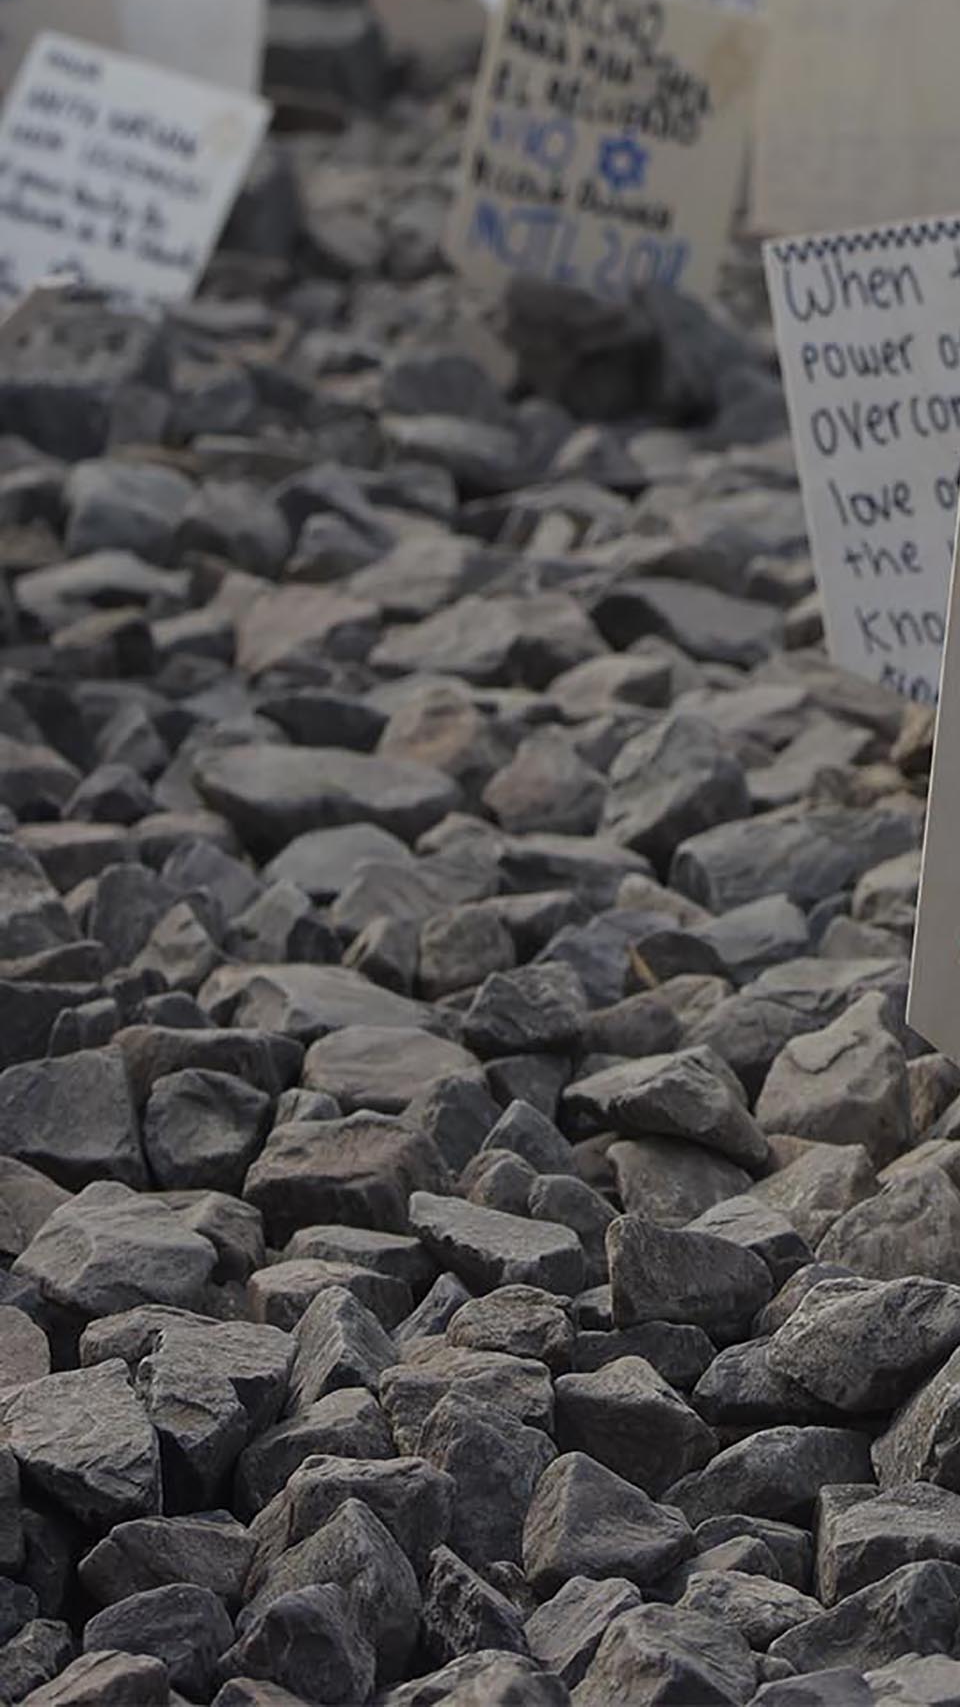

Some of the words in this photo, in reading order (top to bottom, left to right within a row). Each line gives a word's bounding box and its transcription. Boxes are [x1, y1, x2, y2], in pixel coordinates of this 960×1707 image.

[785, 254, 924, 322] When
[800, 333, 914, 383] power
[829, 479, 914, 527] love
[936, 474, 960, 520] o
[844, 540, 924, 580] the
[855, 606, 946, 655] Kno
